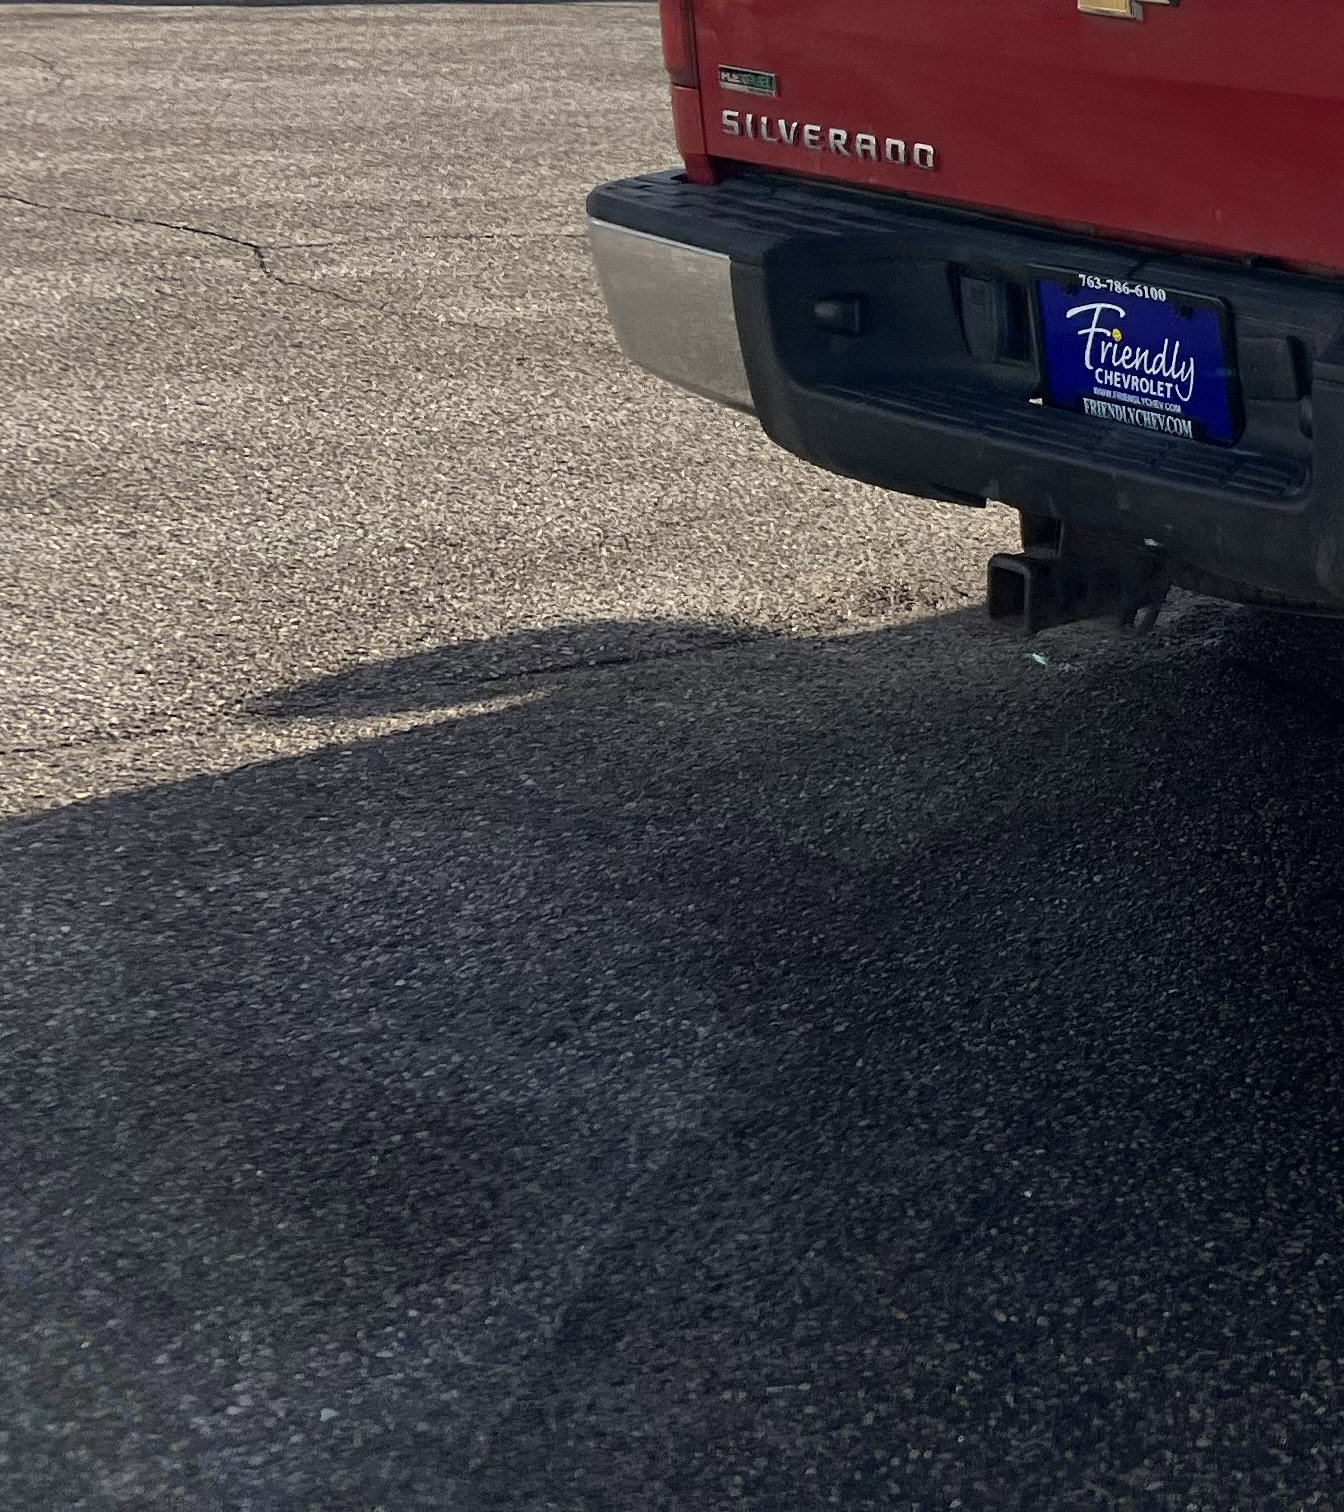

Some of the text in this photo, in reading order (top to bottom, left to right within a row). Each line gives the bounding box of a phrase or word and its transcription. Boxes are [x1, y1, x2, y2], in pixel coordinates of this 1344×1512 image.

[722, 109, 935, 169] SILVERADO
[1078, 274, 1167, 302] 763-786-6100
[1066, 303, 1195, 402] Friendly
[1095, 368, 1173, 399] CHEVROLET
[1083, 397, 1193, 438] FRIENDLYCHEV.COM
